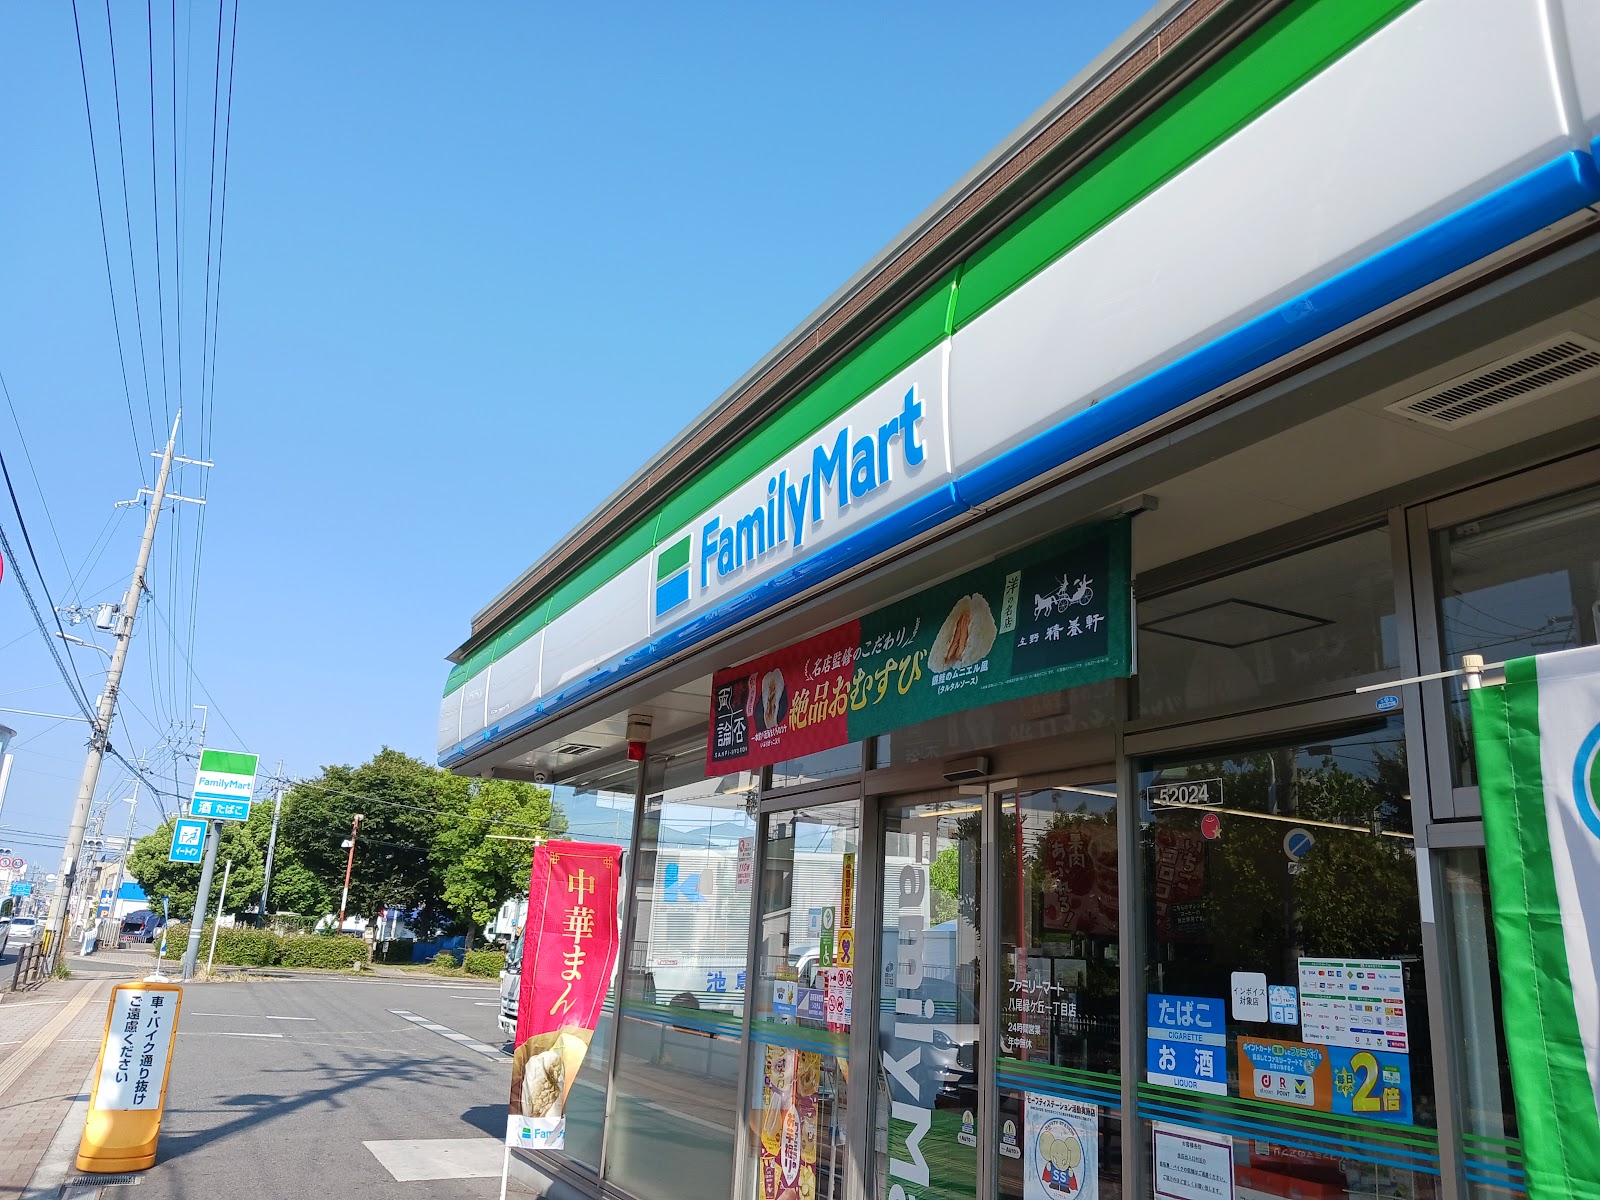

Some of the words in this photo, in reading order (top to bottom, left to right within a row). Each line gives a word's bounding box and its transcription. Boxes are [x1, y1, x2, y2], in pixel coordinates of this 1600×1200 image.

[700, 382, 927, 588] FamilyMart
[1003, 577, 1019, 629] 洋の名店
[1017, 632, 1040, 648] 上野
[1044, 612, 1105, 642] 精養軒
[811, 626, 907, 677] 名店監修のこだわり
[788, 648, 929, 732] 絶品おむすび
[198, 777, 251, 789] FamilyMart
[1160, 783, 1209, 806] 52024
[198, 801, 213, 814] 酒
[215, 804, 243, 816] たばこ
[176, 847, 199, 856] イートイン
[549, 868, 597, 1017] 中華まん
[1008, 979, 1065, 997] ファミリーマート
[1233, 987, 1265, 996] インボイス
[1239, 996, 1259, 1006] 対象店
[1158, 999, 1212, 1028] たばこ
[1008, 1022, 1041, 1036] 24時間営業
[1168, 1031, 1203, 1042] CIGARETTE
[115, 995, 142, 1084] ご遠慮ください
[1008, 1036, 1033, 1050] 年中無休
[133, 995, 165, 1105] 車・バイク通り抜け
[1158, 1044, 1176, 1072] お
[1194, 1048, 1214, 1078] 酒
[1173, 1078, 1198, 1089] LIQUOR
[1337, 1074, 1354, 1085] 毎日
[1053, 1170, 1067, 1183] SS
